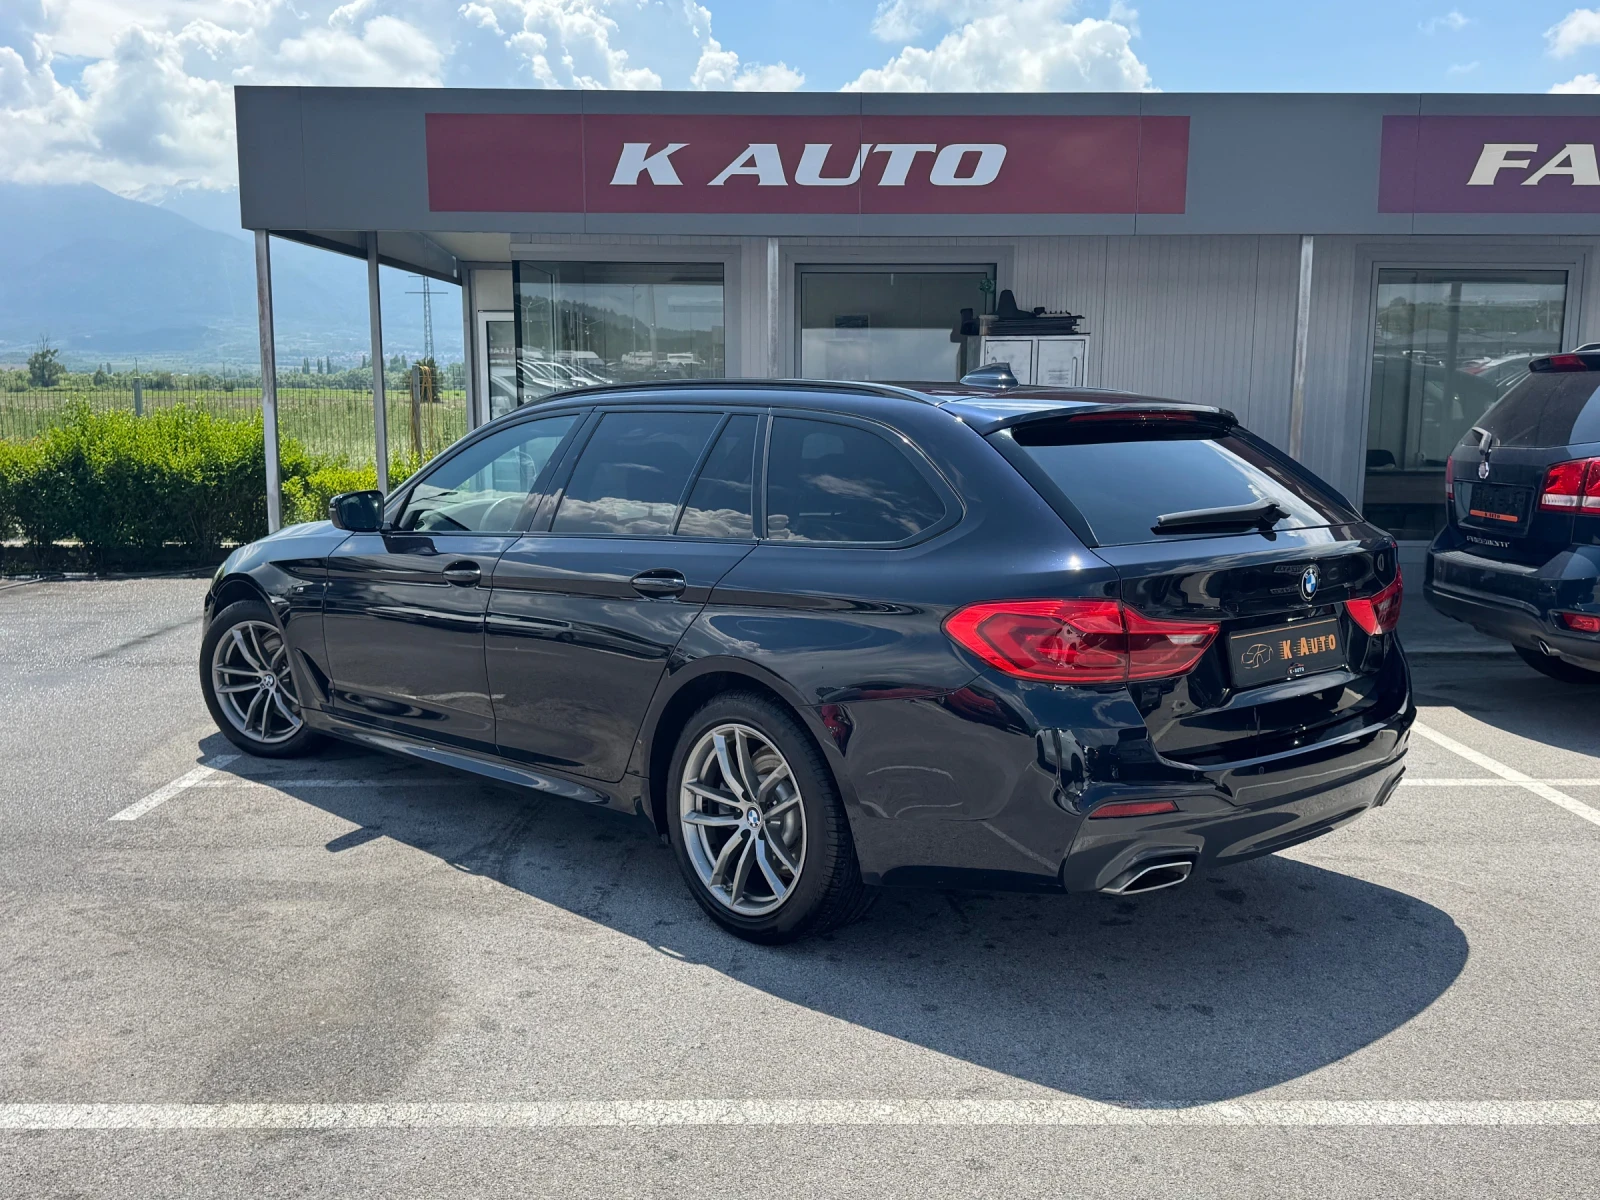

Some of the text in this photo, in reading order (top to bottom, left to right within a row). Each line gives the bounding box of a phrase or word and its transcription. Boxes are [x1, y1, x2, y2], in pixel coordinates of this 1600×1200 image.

[609, 143, 1007, 186] K AUTO
[1466, 143, 1600, 186] FA
[1280, 633, 1337, 660] K AUTO
